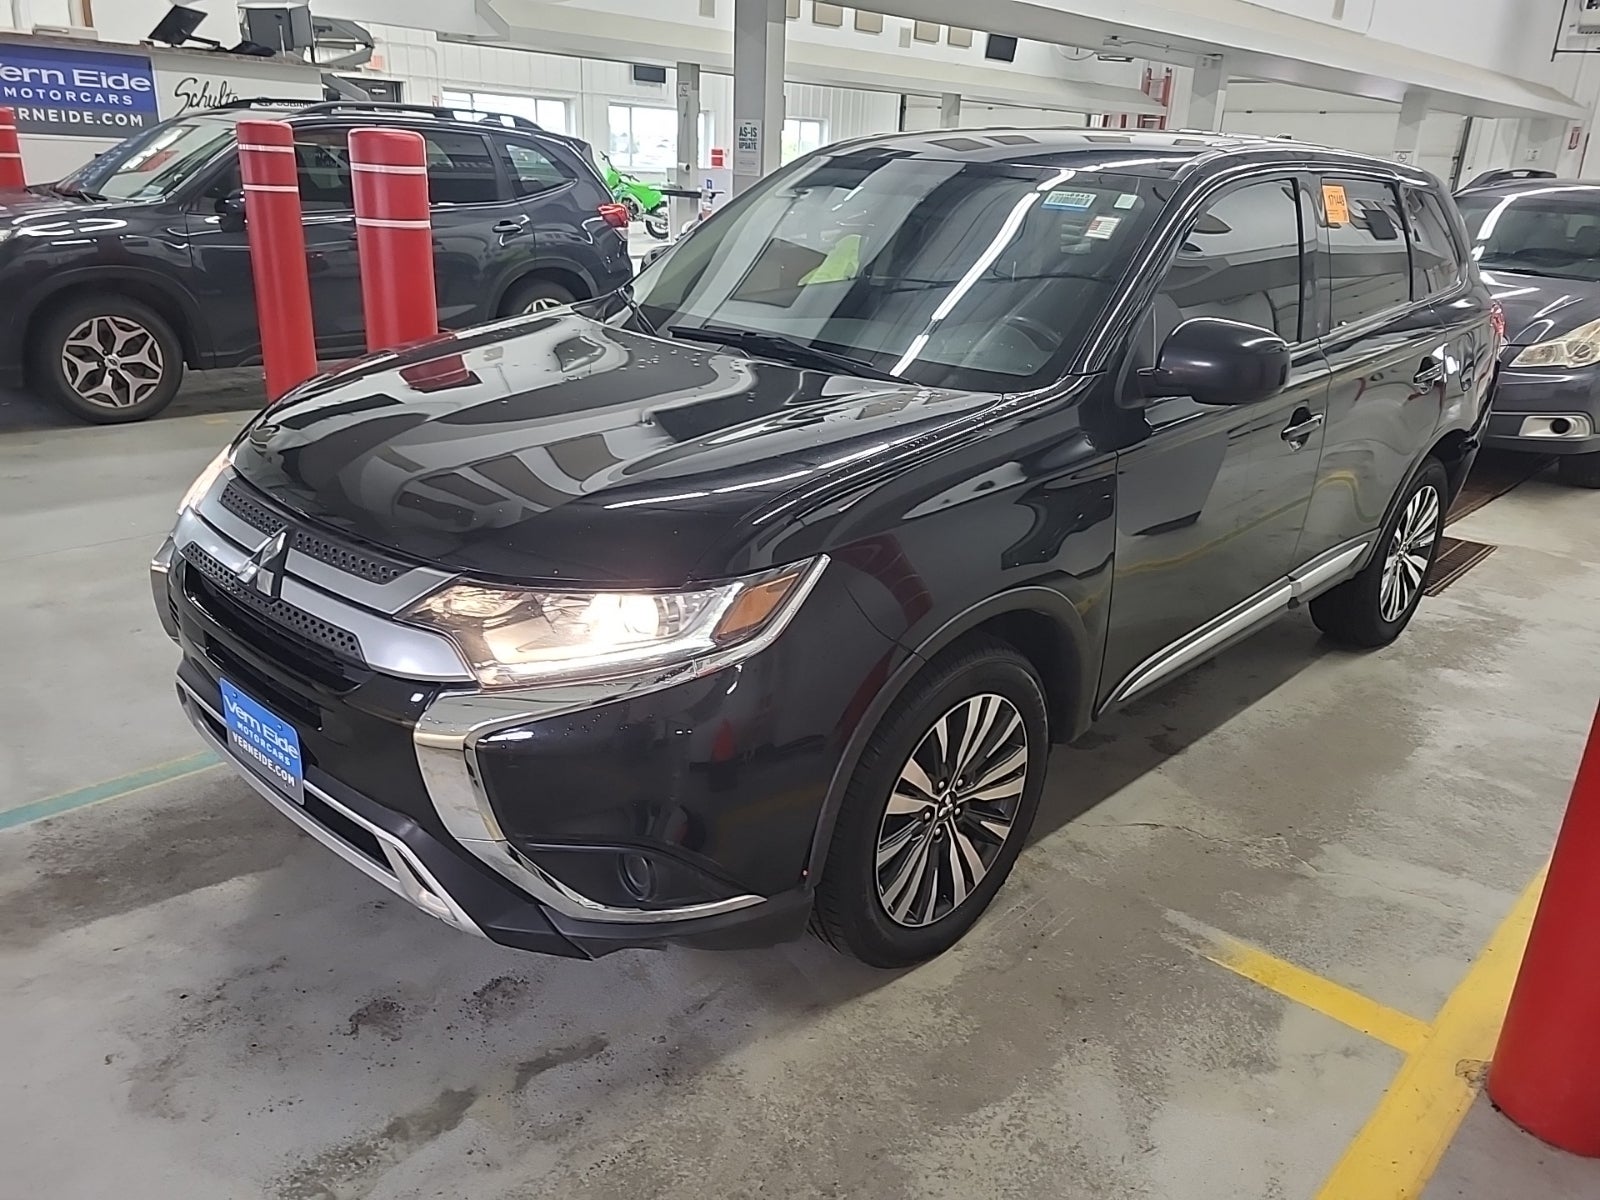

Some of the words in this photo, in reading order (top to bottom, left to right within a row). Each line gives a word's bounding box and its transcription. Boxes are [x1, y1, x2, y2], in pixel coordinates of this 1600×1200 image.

[0, 63, 65, 86] ern
[72, 69, 151, 92] Eide
[4, 87, 133, 105] MOTORCARS
[17, 107, 143, 127] RNEIDE.COM
[739, 126, 757, 138] AS-IS
[223, 694, 262, 734] Vern
[261, 723, 299, 759] Eide
[236, 721, 291, 766] MOTORCARS
[231, 731, 296, 787] VERNEIDE.COM
